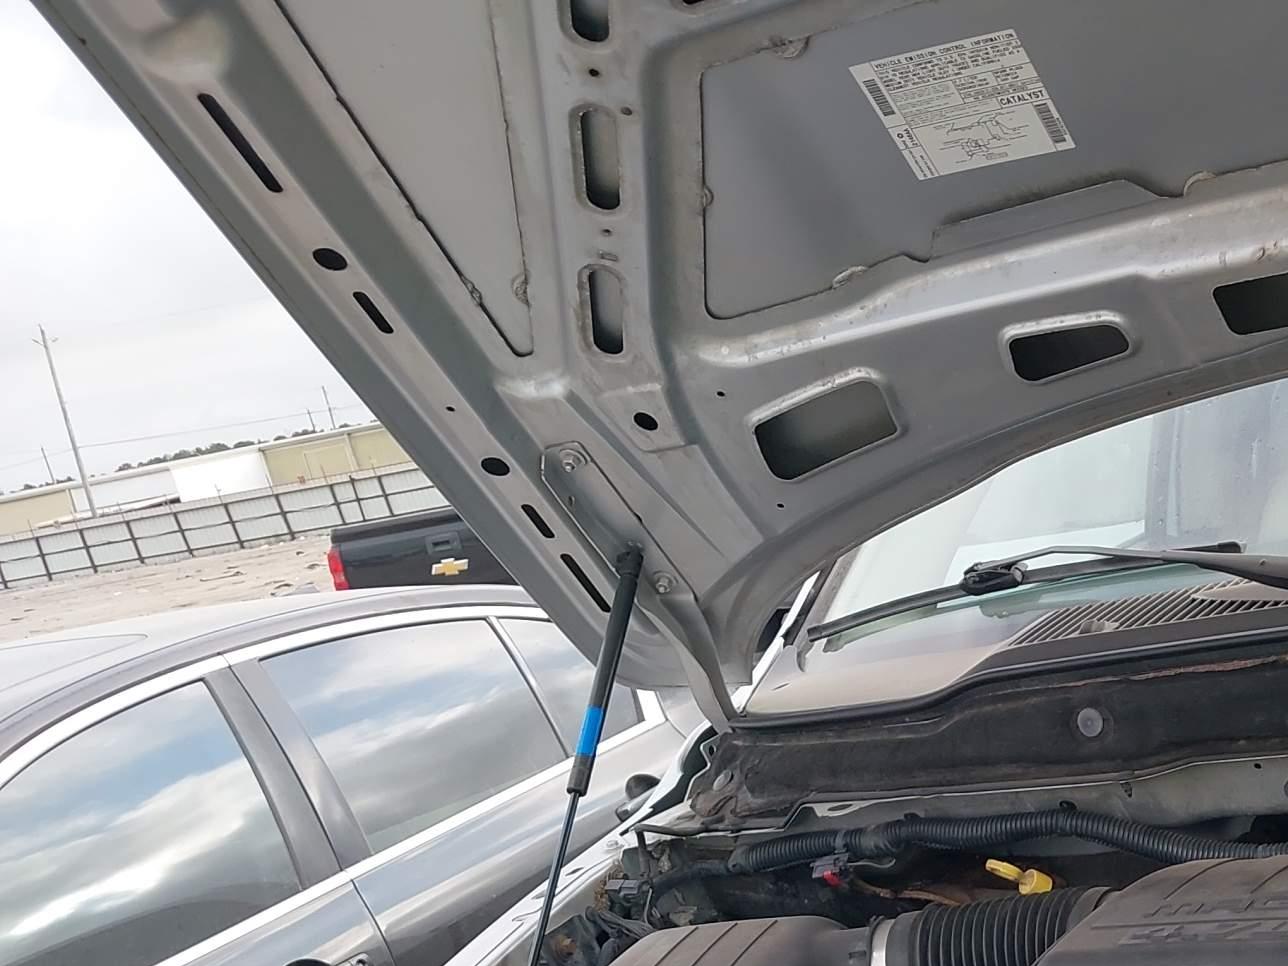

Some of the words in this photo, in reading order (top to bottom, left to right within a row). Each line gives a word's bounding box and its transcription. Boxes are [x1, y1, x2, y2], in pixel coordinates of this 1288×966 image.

[874, 59, 902, 69] VEHICLE
[904, 51, 937, 62] EMISSION
[939, 44, 967, 54] CONTROL
[970, 33, 1014, 46] INFORMATION
[999, 89, 1045, 106] CATALYST
